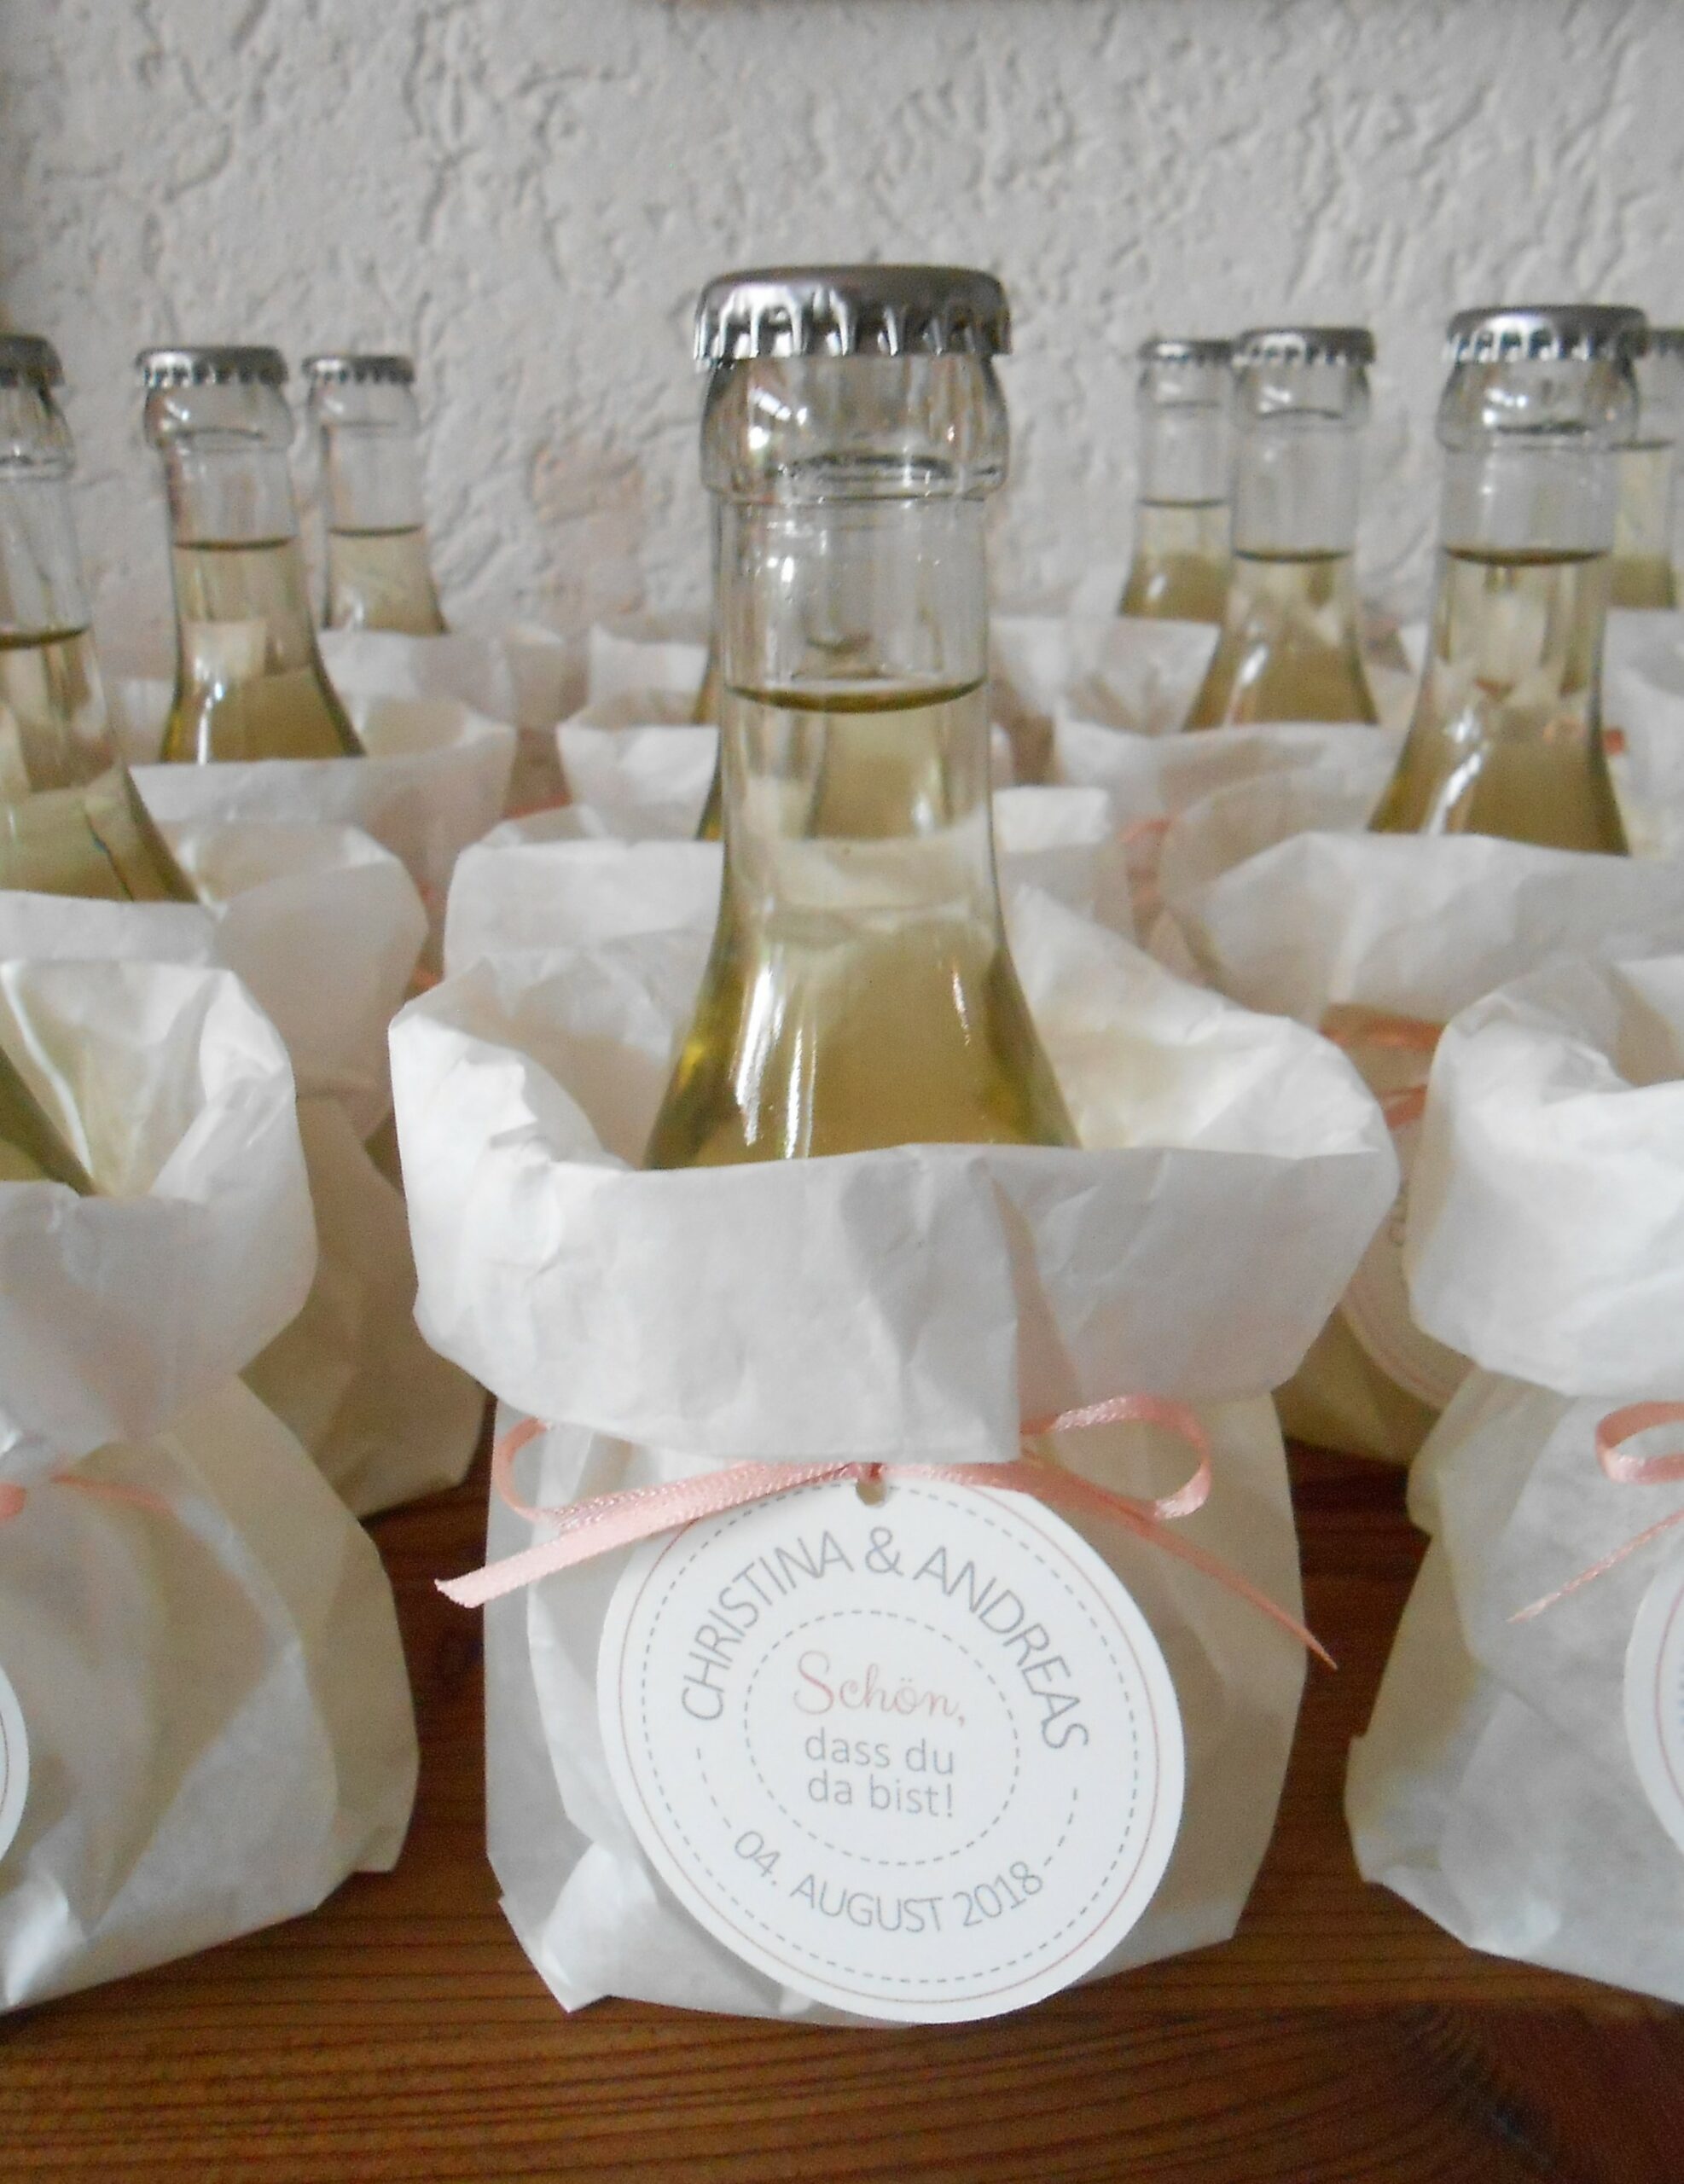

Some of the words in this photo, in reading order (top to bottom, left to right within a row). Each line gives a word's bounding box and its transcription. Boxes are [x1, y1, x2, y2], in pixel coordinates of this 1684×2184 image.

[682, 1531, 855, 1721] CHRISTINA
[864, 1526, 902, 1576] &
[913, 1545, 1089, 1751] ANDREAS
[793, 1650, 966, 1727] Schön,
[804, 1727, 891, 1769] dass
[905, 1738, 955, 1774] du
[807, 1769, 853, 1806] da
[869, 1774, 955, 1818] bist!
[733, 1829, 779, 1886] 04.
[789, 1873, 944, 1933] AUGUST
[954, 1860, 1044, 1928] 2018
